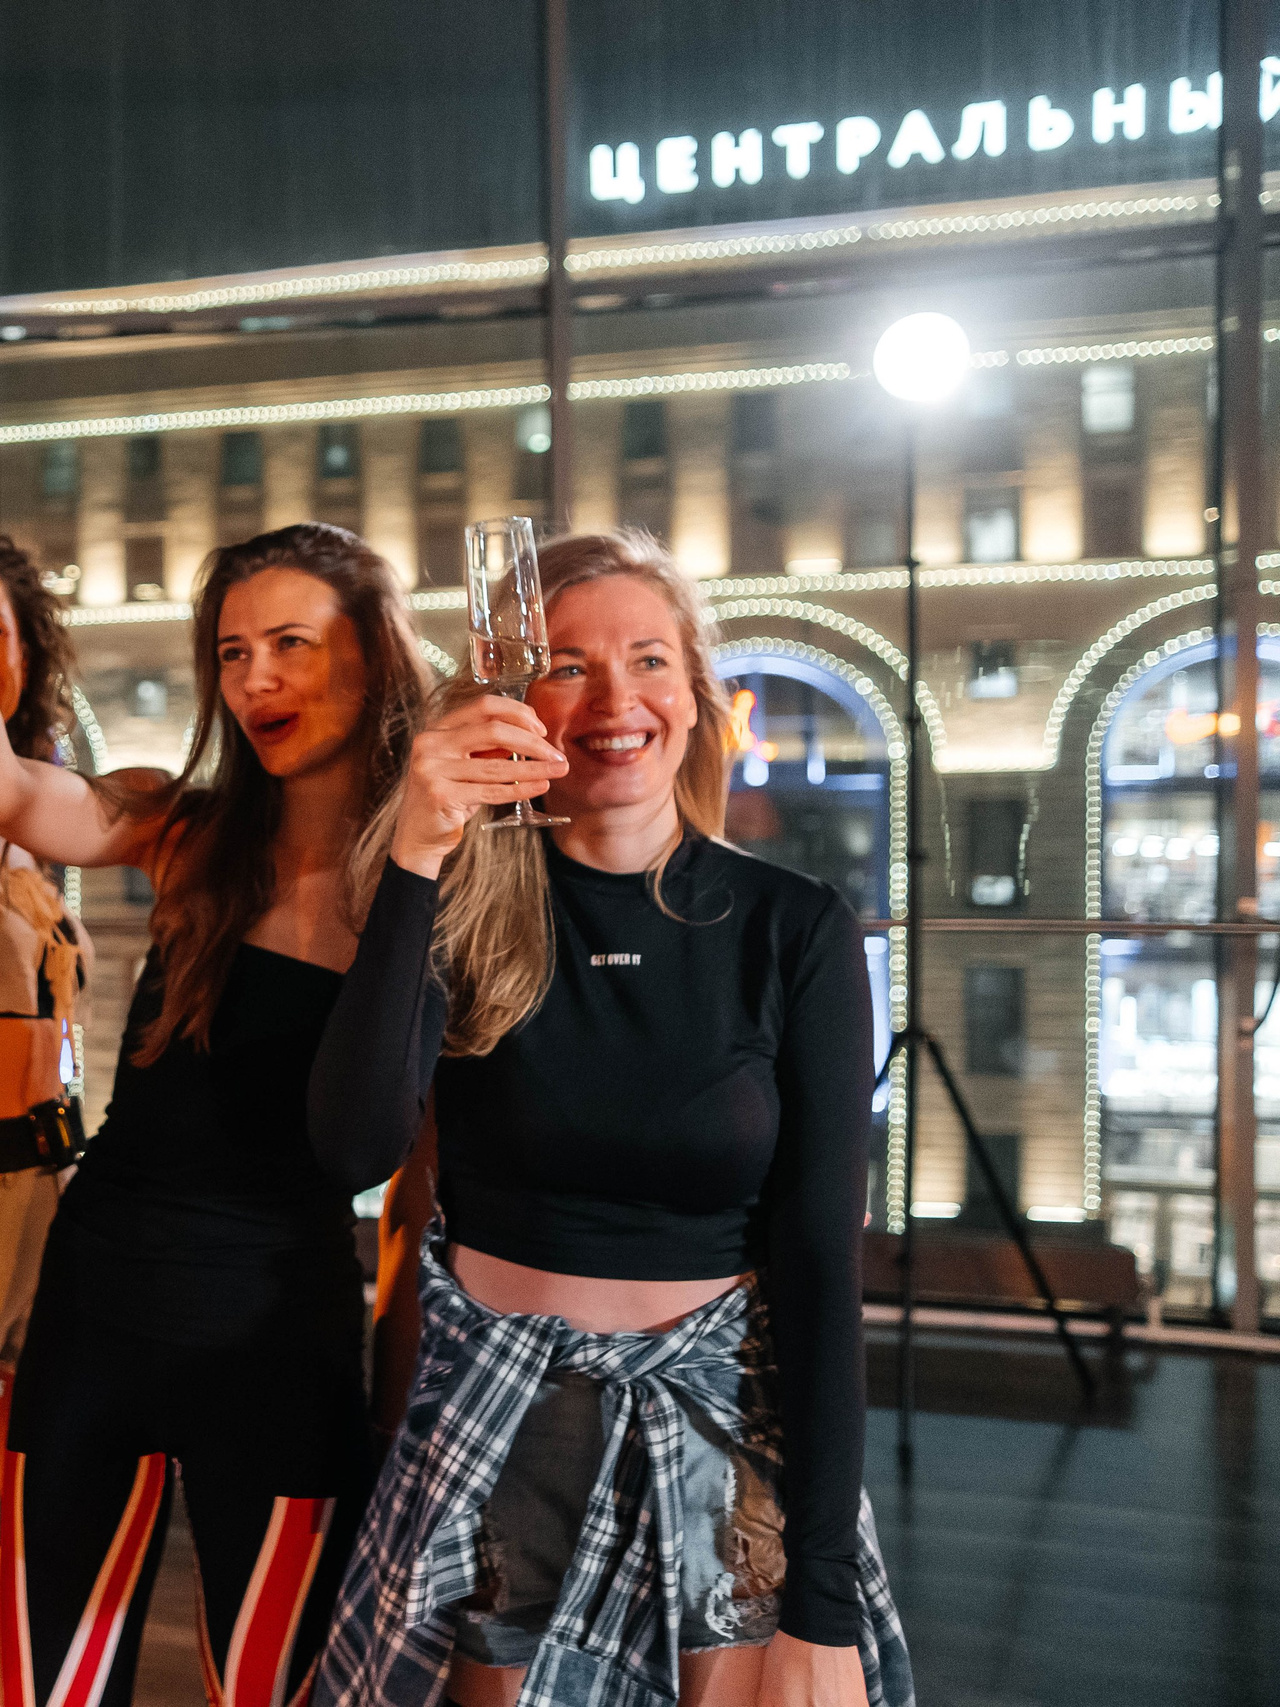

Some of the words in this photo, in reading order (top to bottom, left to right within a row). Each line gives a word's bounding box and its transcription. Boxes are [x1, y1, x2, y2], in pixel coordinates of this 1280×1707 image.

[591, 954, 606, 966] GET
[607, 953, 631, 966] OVER
[631, 953, 642, 966] IT
